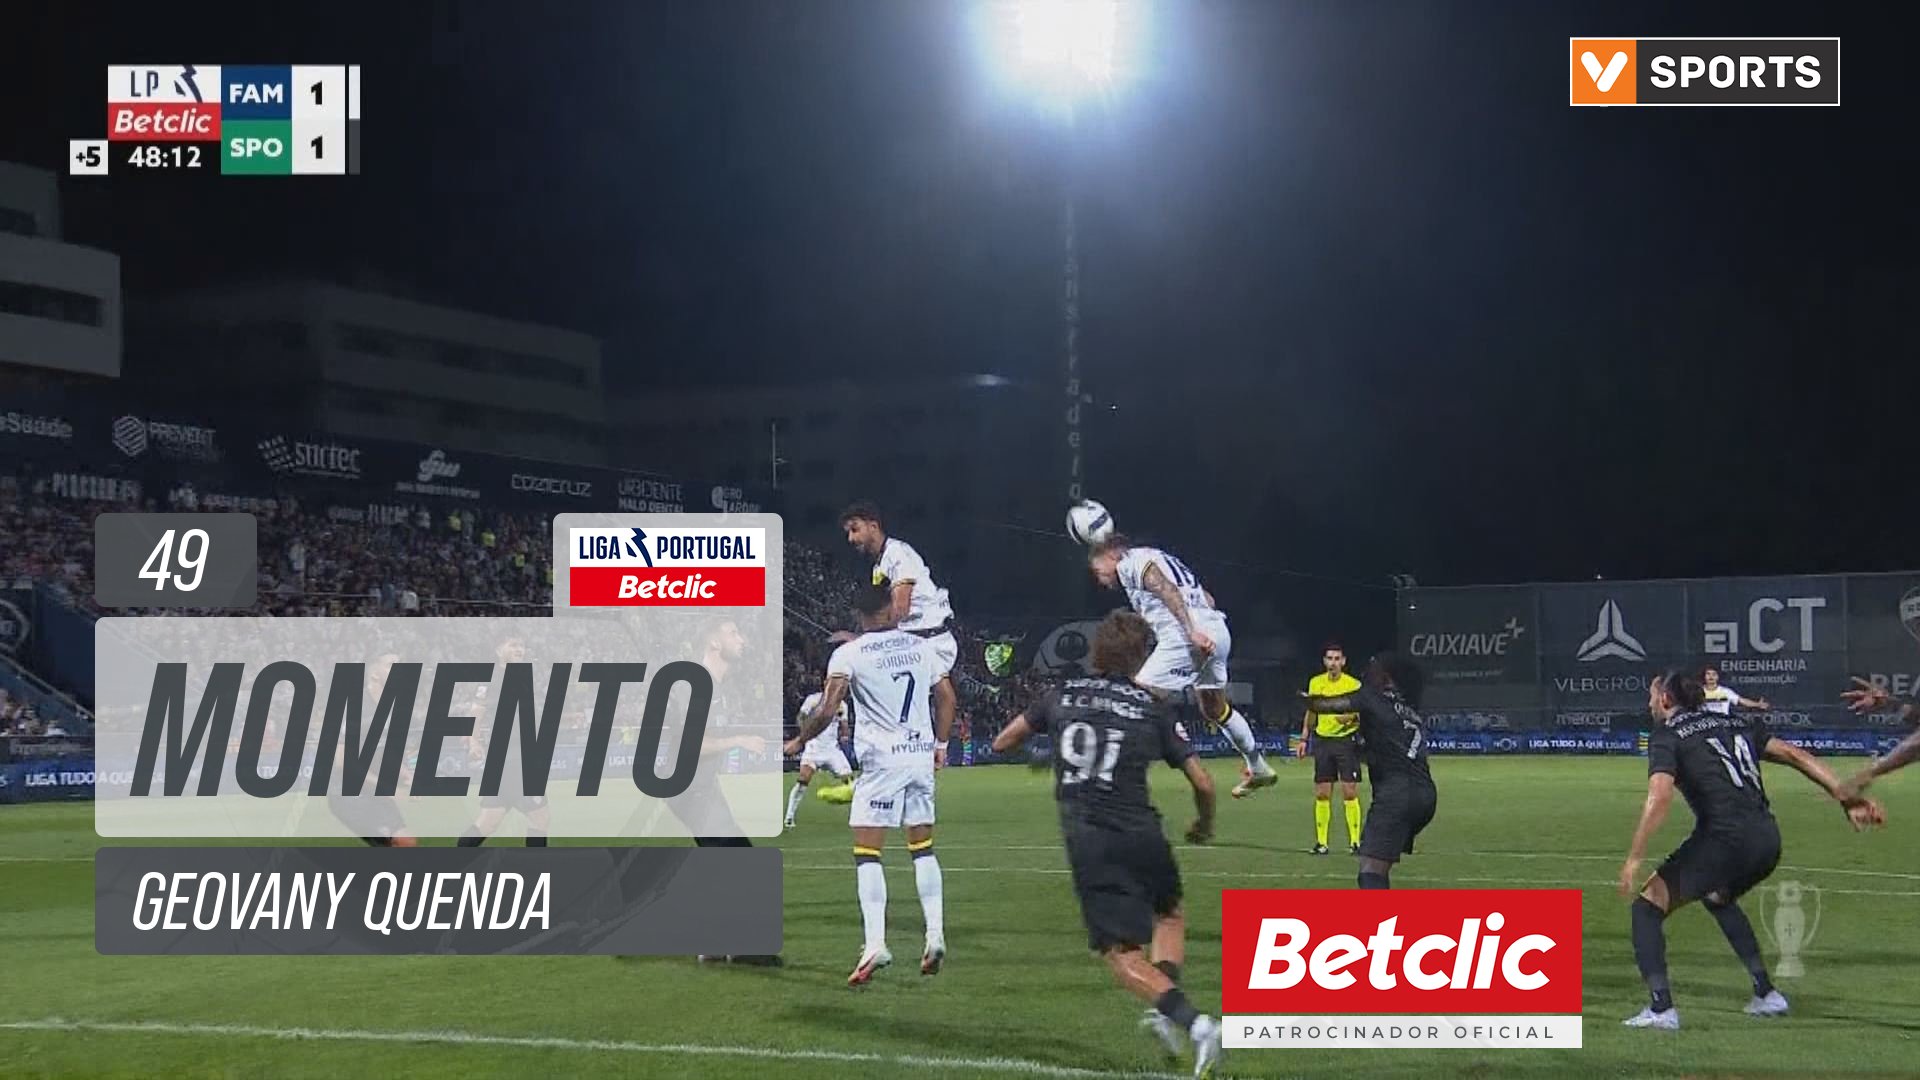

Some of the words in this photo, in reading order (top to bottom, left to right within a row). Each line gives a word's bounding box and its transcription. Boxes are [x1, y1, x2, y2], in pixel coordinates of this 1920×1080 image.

[1720, 658, 1808, 673] ENGENHARIA
[1554, 675, 1651, 692] VLBGROU
[890, 671, 916, 723] 7
[1528, 738, 1549, 749] LIGA
[1550, 738, 1576, 749] TUDO
[1586, 738, 1604, 751] QUE
[1814, 739, 1834, 750] QUE
[1060, 721, 1125, 785] 91
[1705, 734, 1762, 789] 14
[24, 773, 58, 787] LIGA
